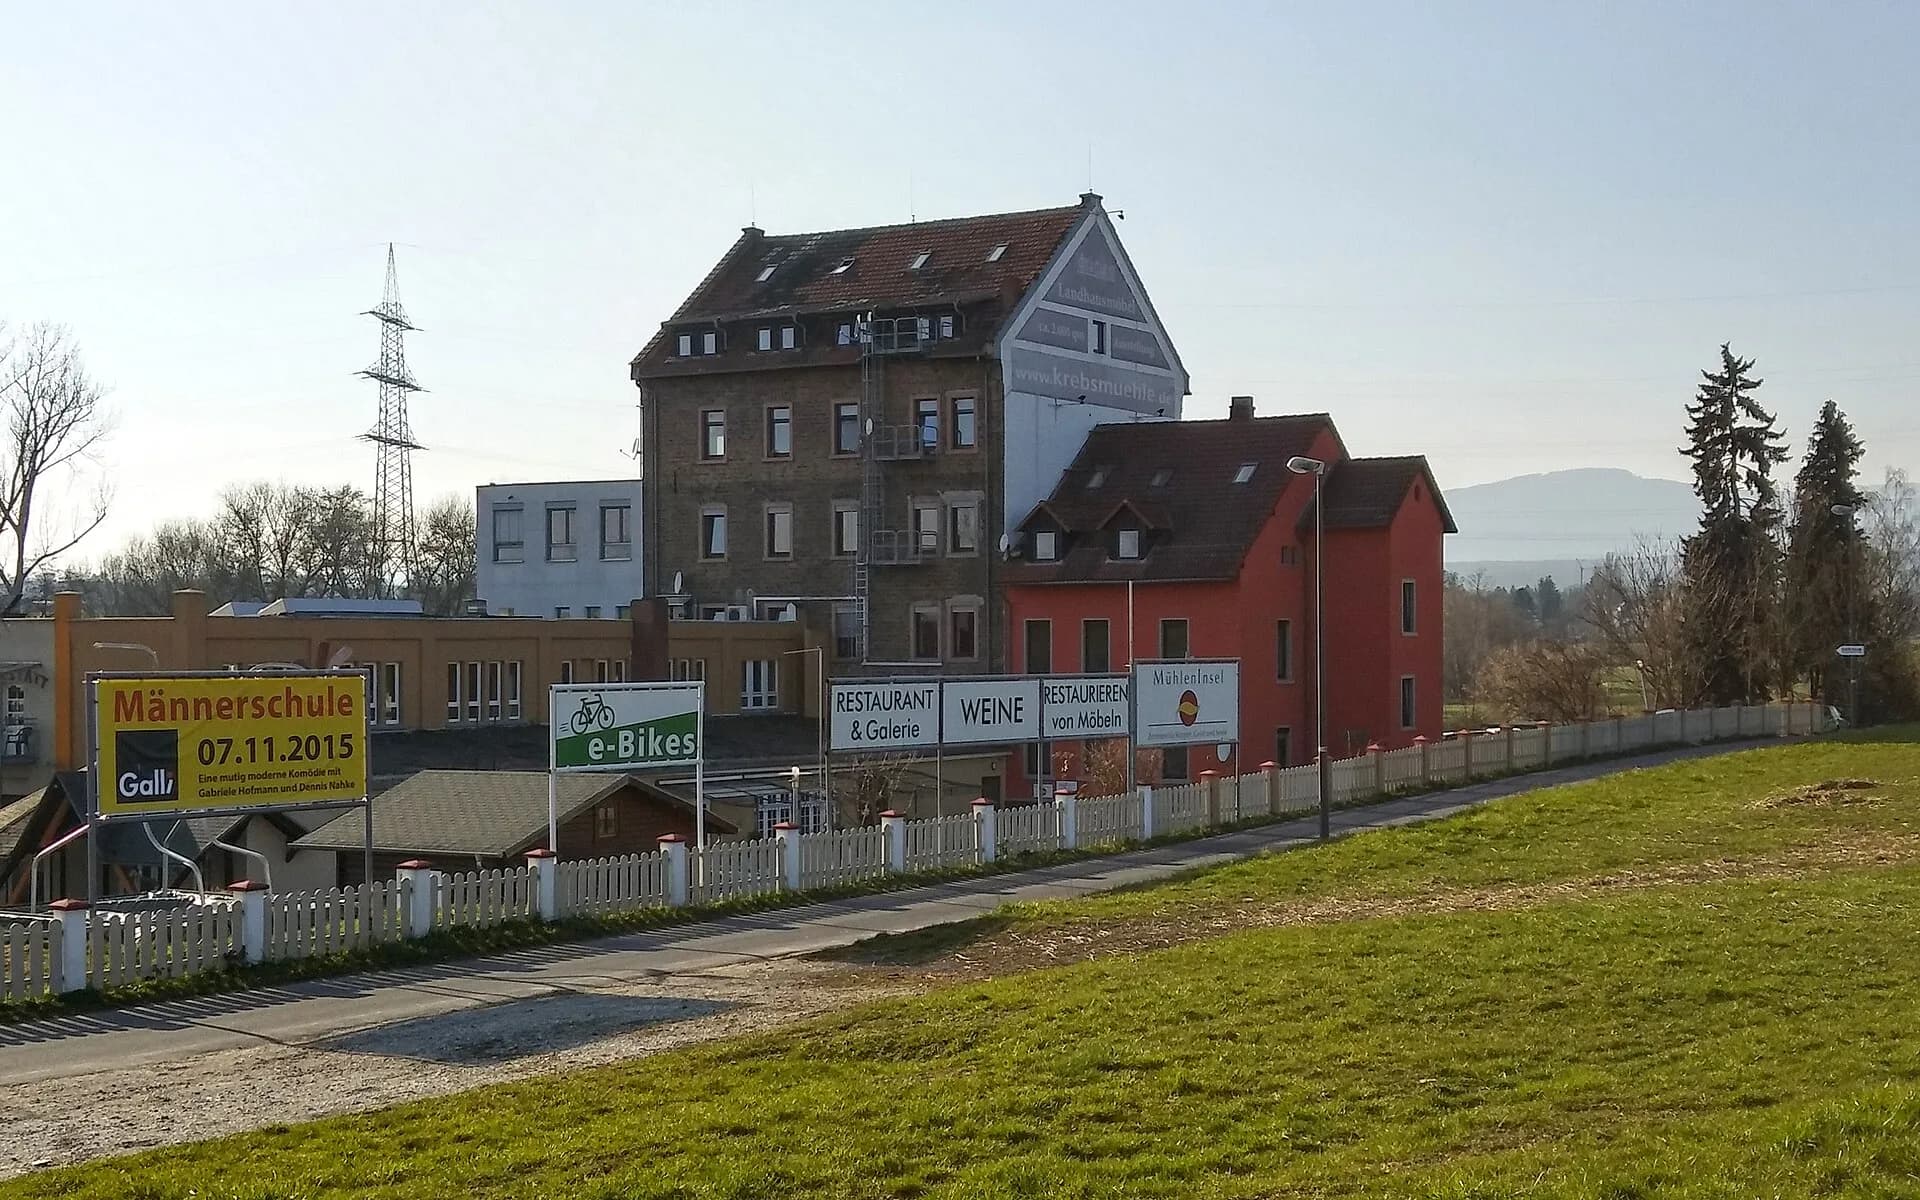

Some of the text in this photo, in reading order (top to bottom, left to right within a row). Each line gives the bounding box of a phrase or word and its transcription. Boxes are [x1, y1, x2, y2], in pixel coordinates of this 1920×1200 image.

[1153, 668, 1225, 686] MühlenInsel
[114, 686, 353, 722] Männerschule
[836, 690, 934, 713] RESTAURANT
[1044, 684, 1129, 705] RESTAURIEREN
[961, 697, 1024, 725] WEINE
[1052, 711, 1122, 730] von Möbeln
[851, 718, 921, 741] & Galerie
[198, 734, 353, 766] 07.11.2015
[588, 727, 696, 760] e-Bikes
[119, 769, 174, 798] Galli
[198, 767, 341, 784] Eine mutig moderne Komödie mit
[198, 779, 355, 798] Gabriele Hofmann und Dennis Nahke
